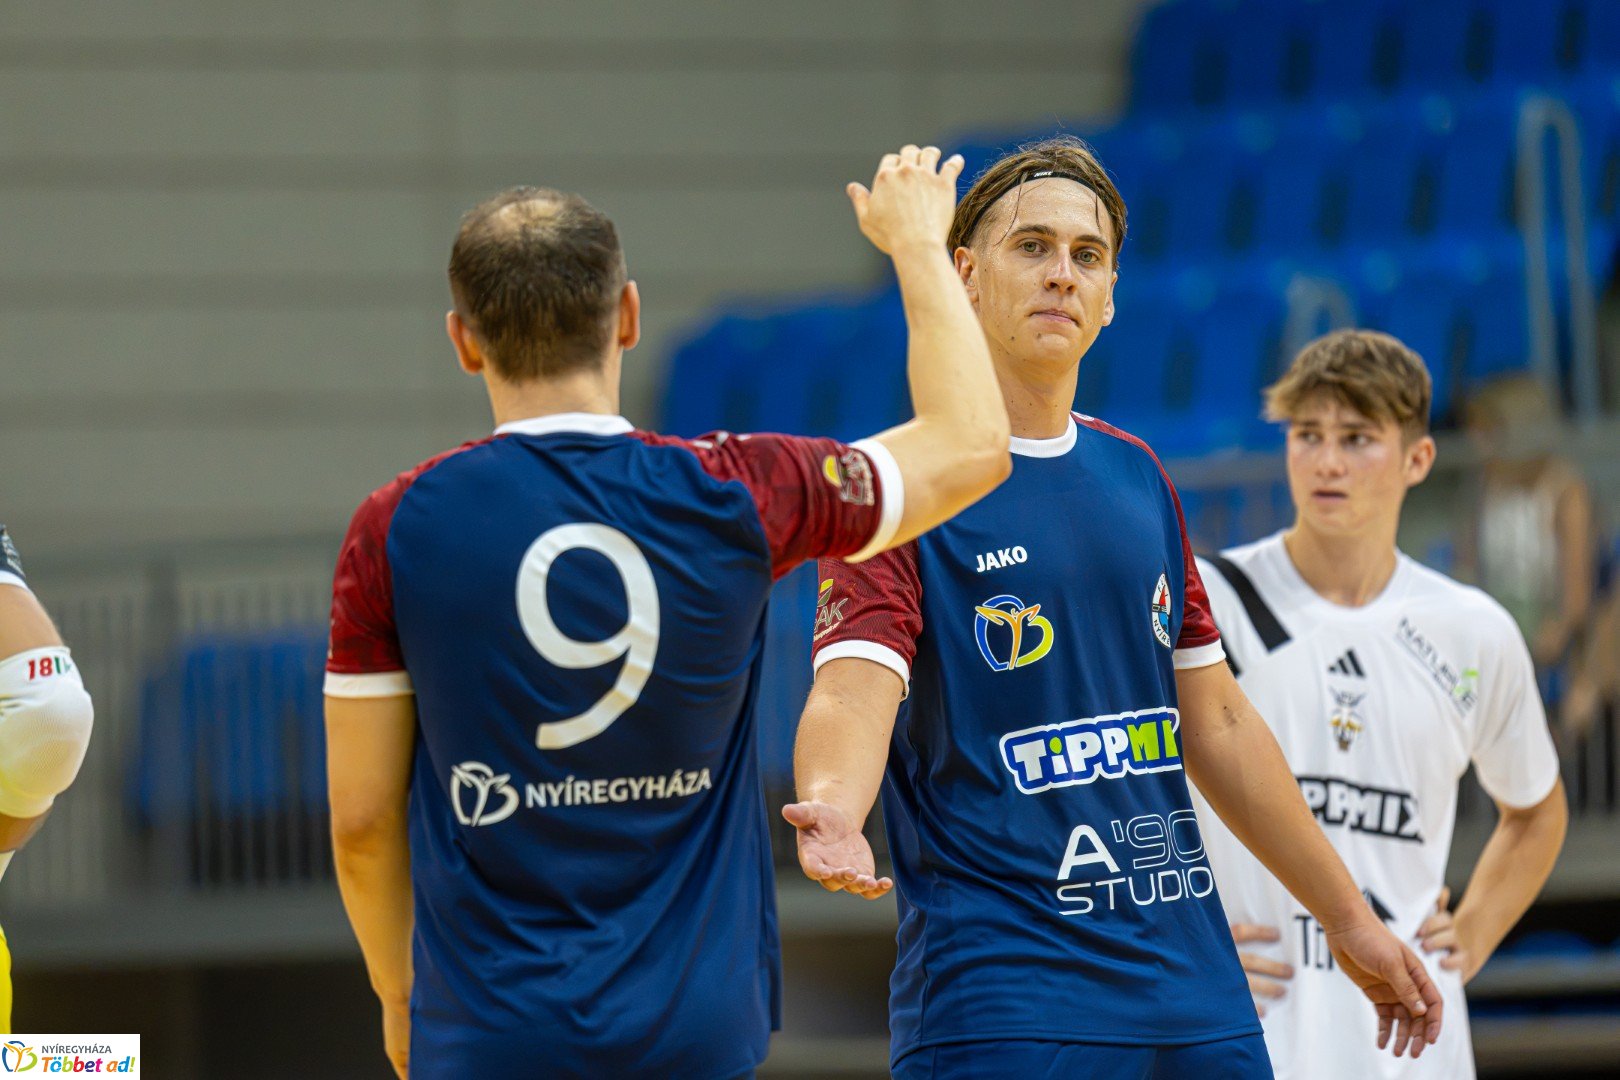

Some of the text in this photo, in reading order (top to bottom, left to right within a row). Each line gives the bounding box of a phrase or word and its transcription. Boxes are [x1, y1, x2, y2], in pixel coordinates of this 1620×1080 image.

[976, 545, 1028, 572] JAKO
[515, 522, 661, 750] 9
[525, 767, 712, 808] NYÍREGYHÁZA
[1056, 866, 1214, 916] STUDIO
